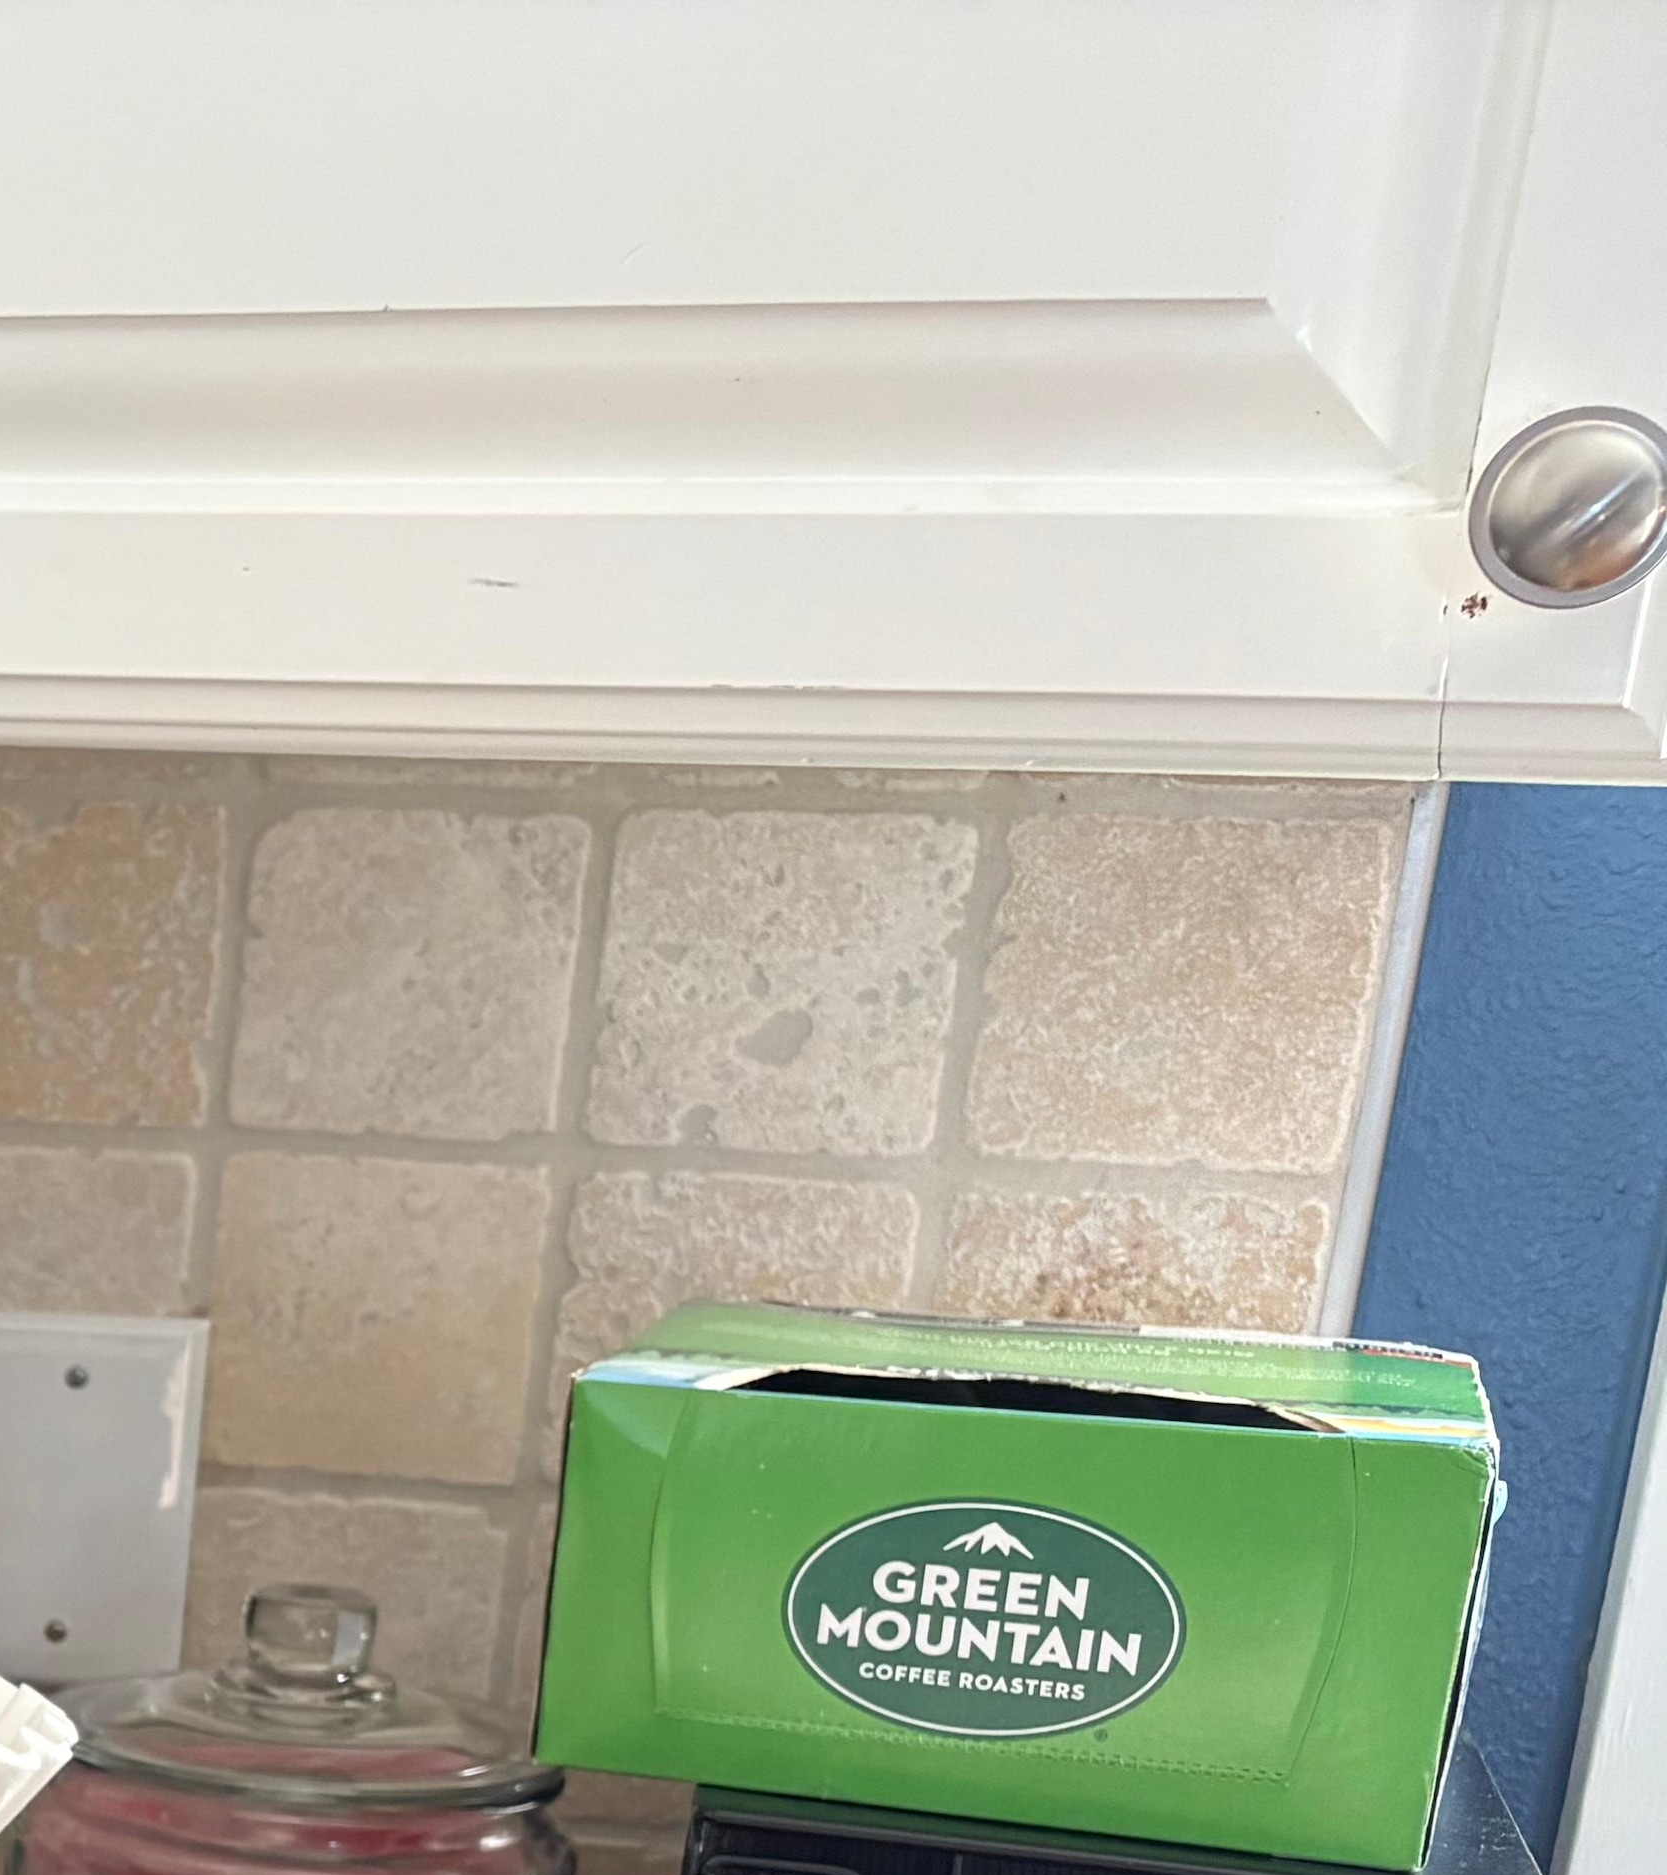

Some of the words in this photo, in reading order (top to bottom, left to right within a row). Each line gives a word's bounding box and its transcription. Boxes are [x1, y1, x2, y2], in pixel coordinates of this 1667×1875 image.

[872, 1562, 1090, 1622] GREEN
[816, 1603, 1144, 1677] MOUNTAIN
[858, 1661, 951, 1688] COFFEE
[959, 1672, 1087, 1702] ROASTERS
